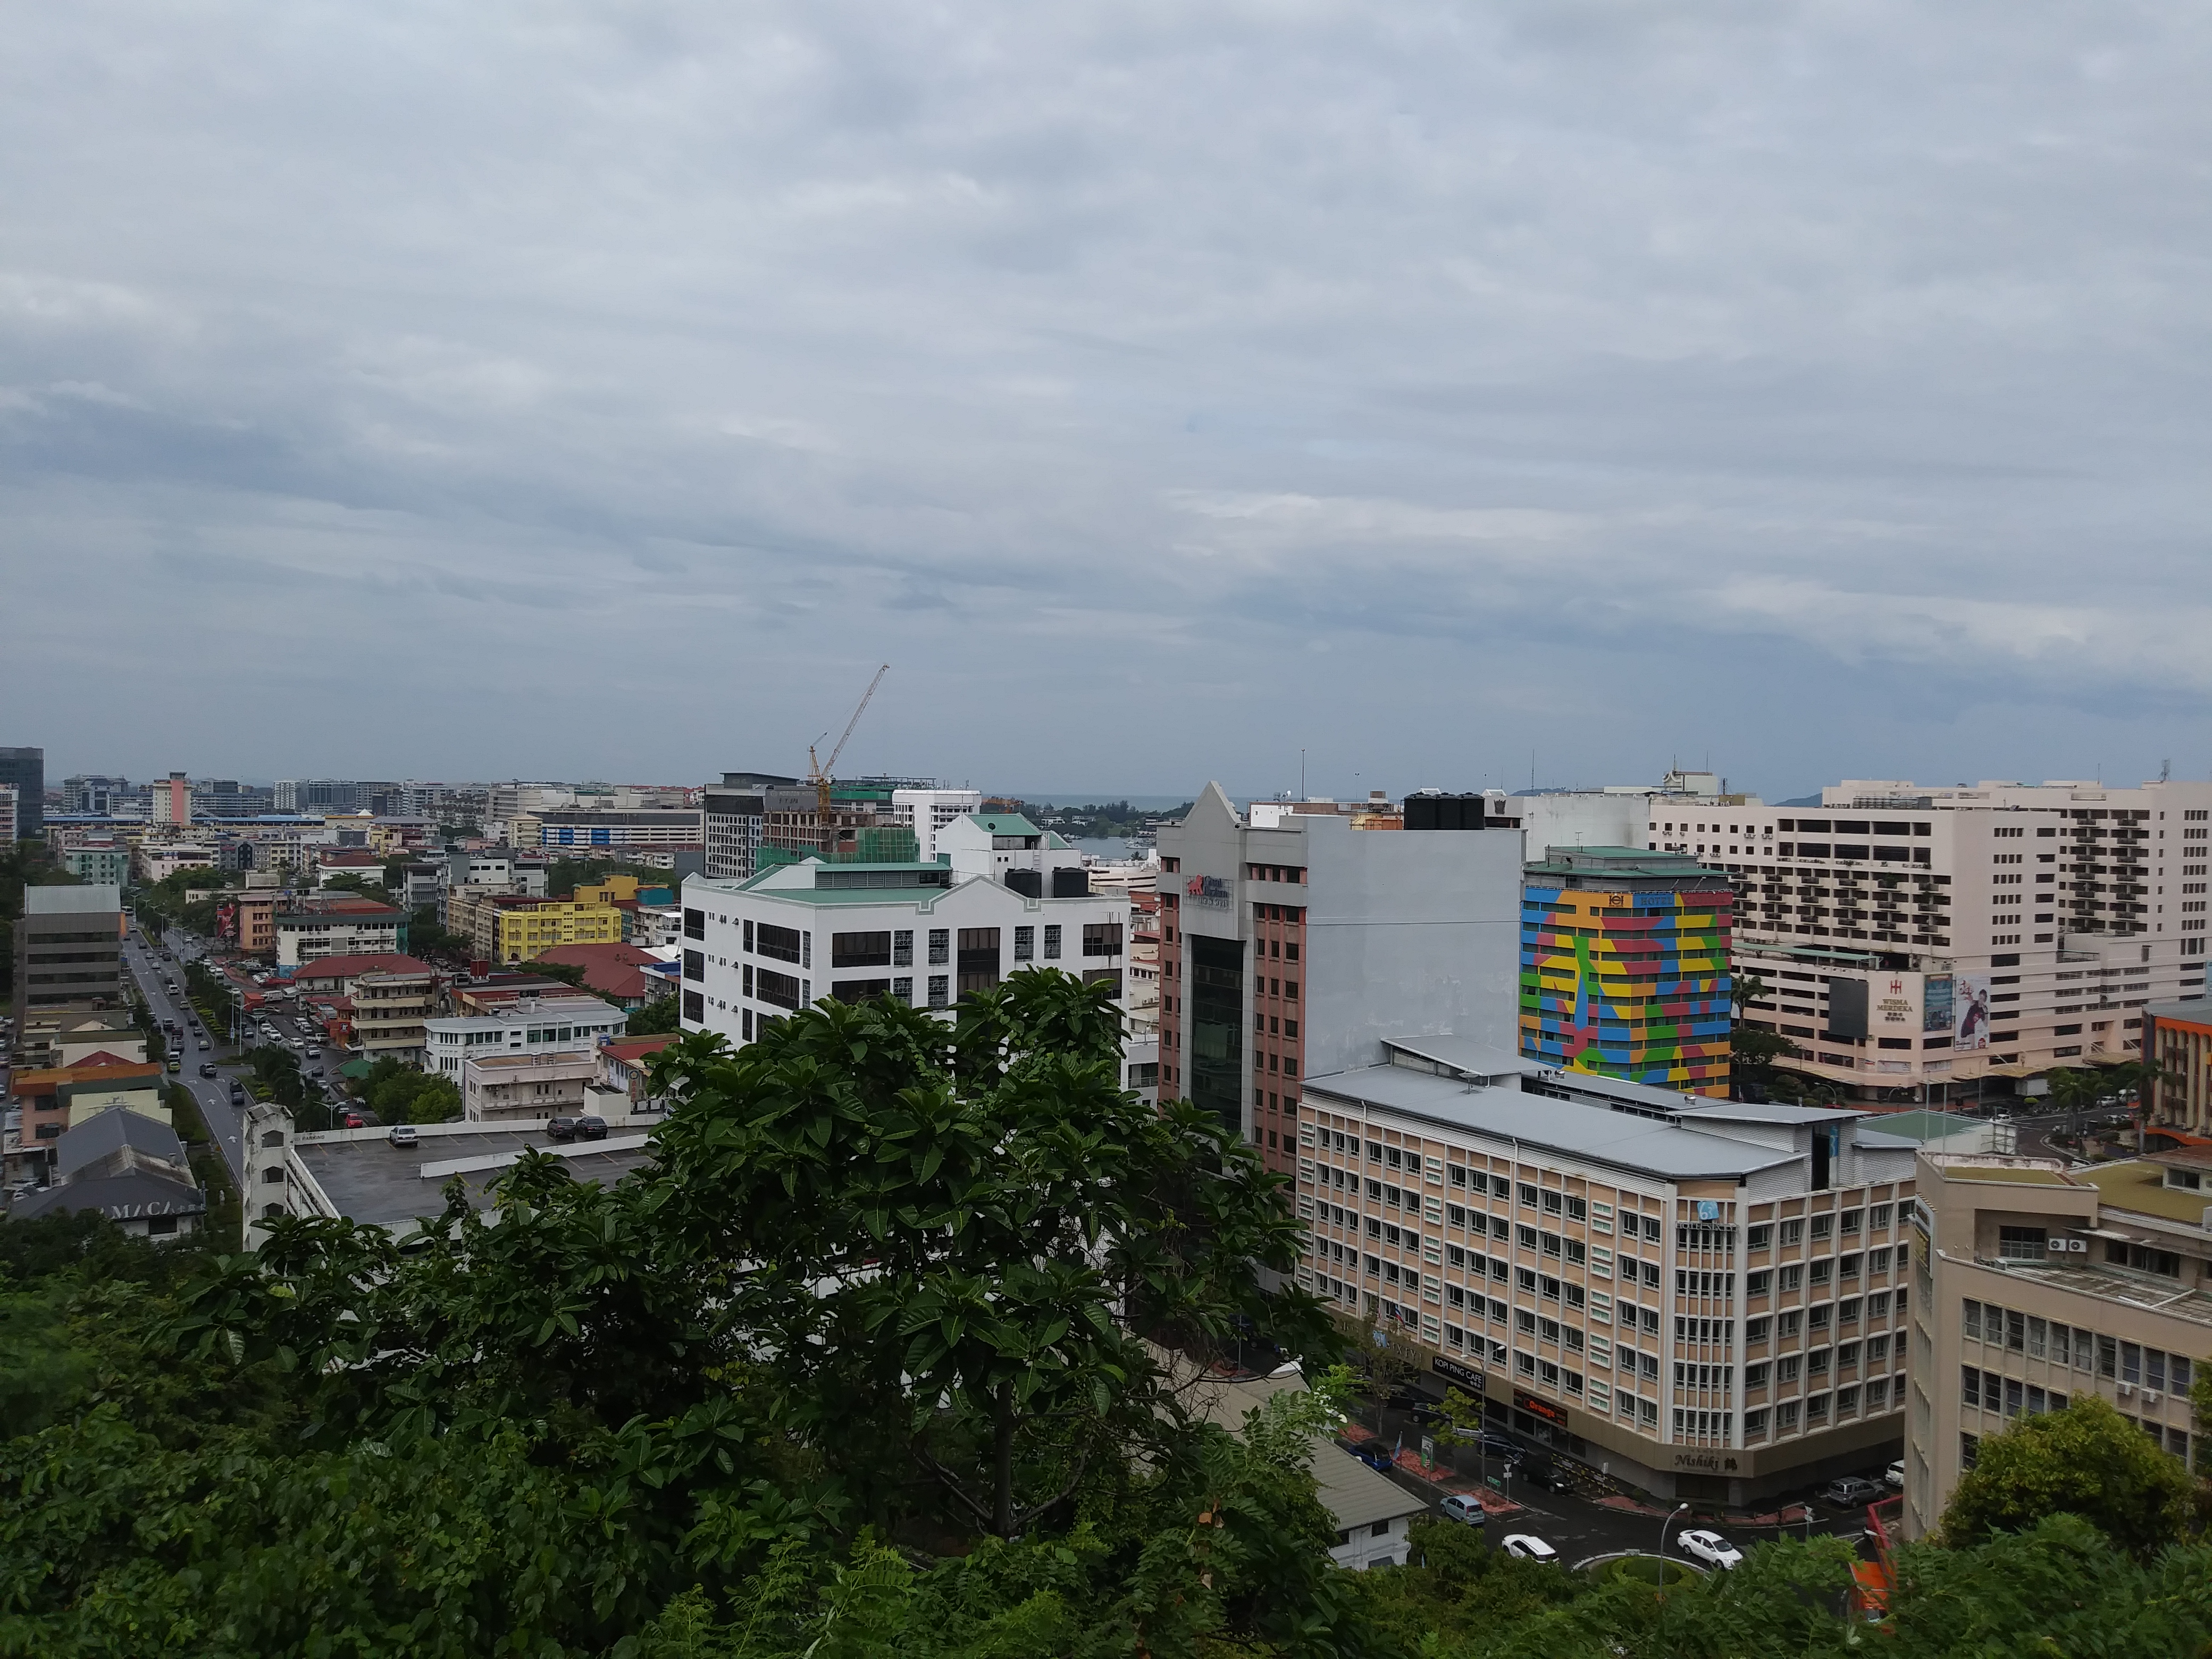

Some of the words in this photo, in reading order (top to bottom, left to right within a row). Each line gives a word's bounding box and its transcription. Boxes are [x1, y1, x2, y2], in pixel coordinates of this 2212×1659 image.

[1435, 1358, 1448, 1370] KOPI
[1449, 1364, 1464, 1376] PING
[1466, 1371, 1482, 1384] CAFE
[1529, 1401, 1555, 1418] Orange
[1674, 1454, 1719, 1470] Nishiki
